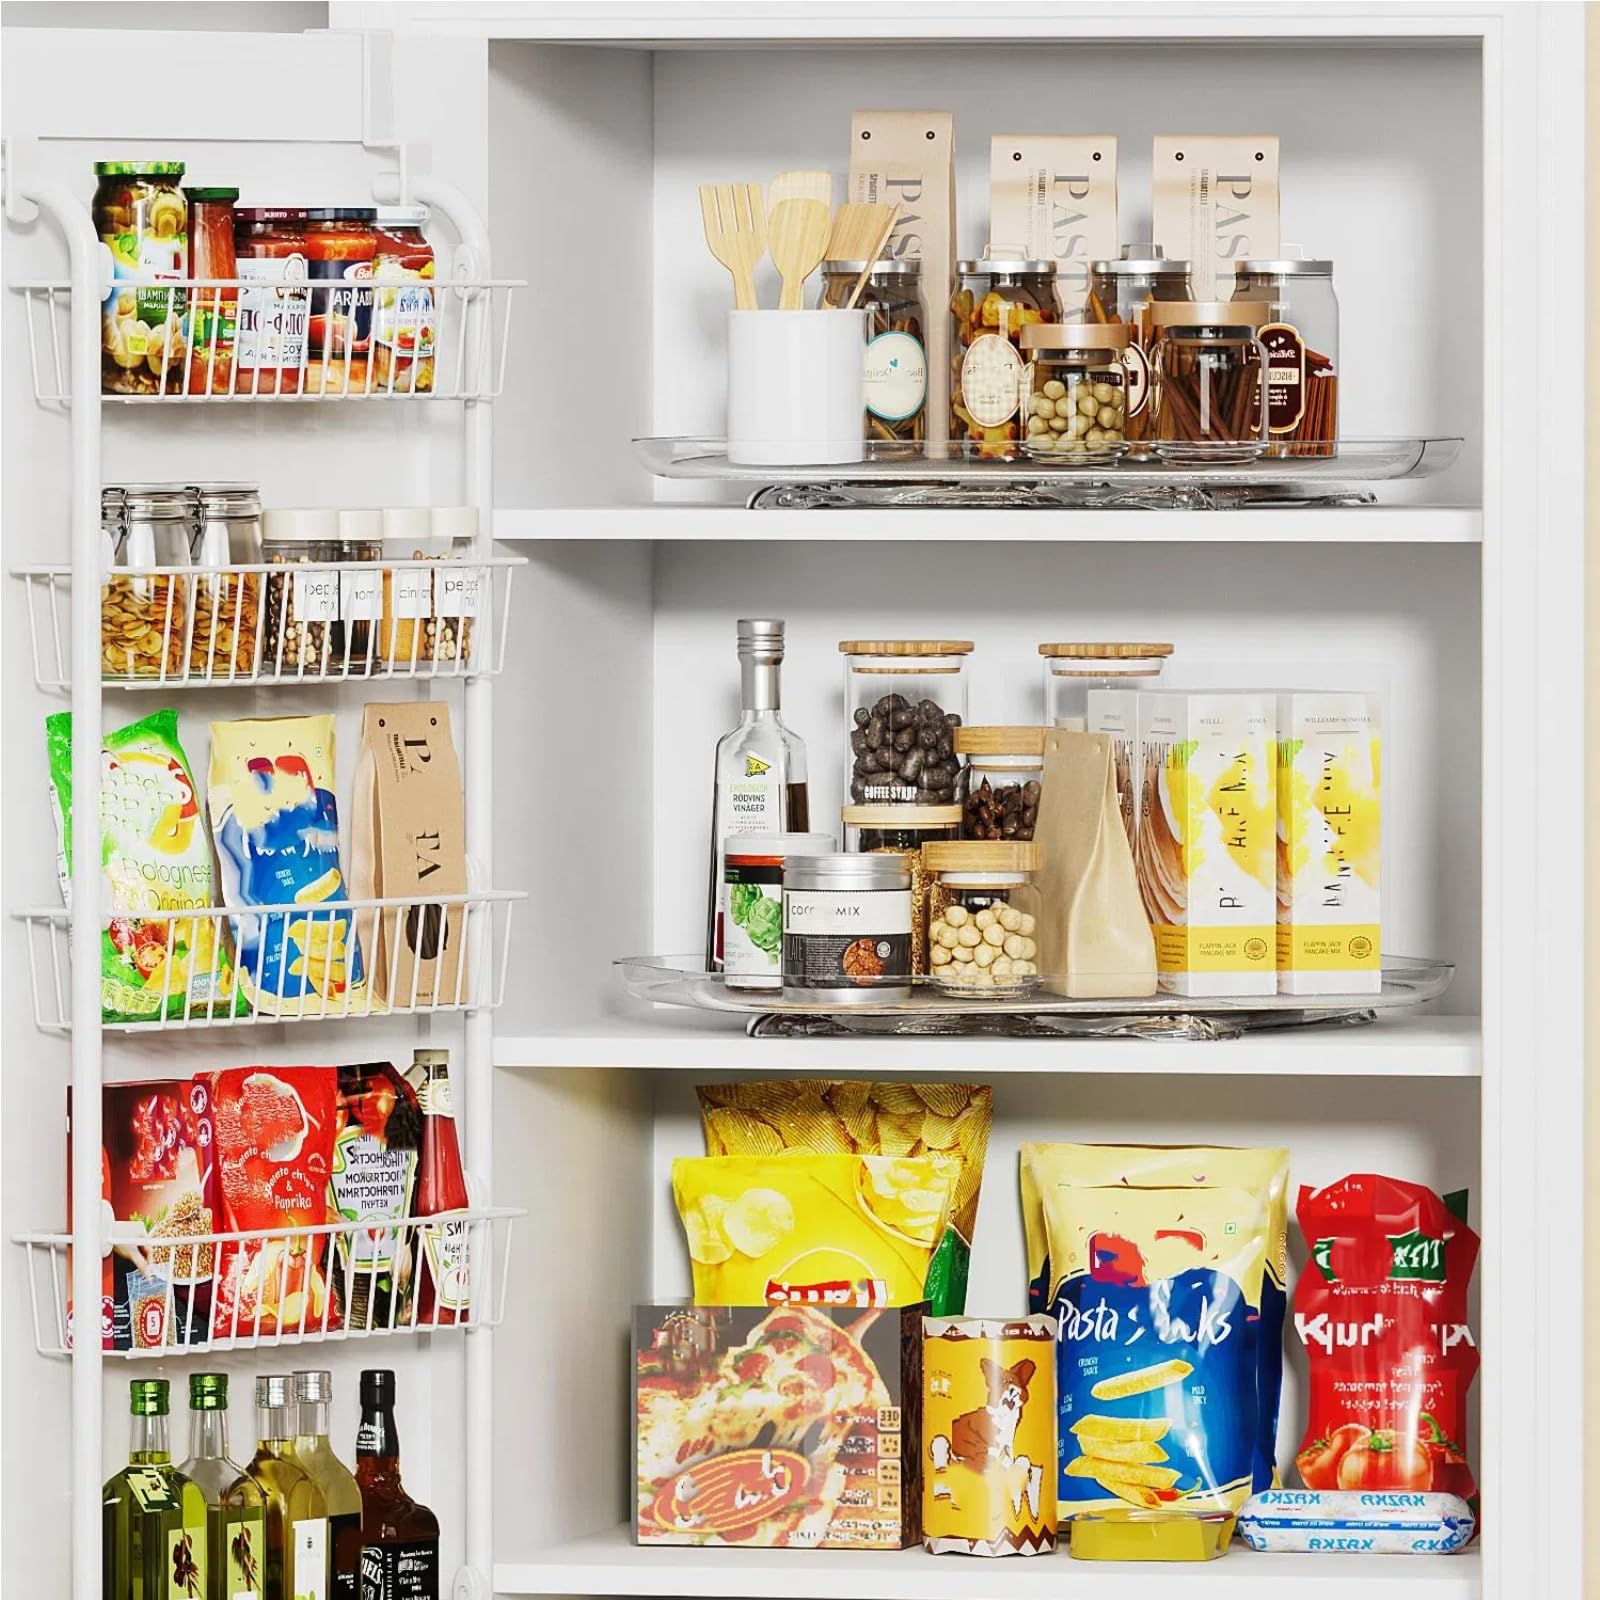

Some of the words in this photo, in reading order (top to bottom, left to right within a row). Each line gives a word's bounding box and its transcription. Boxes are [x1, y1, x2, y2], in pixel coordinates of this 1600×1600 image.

[835, 906, 861, 916] MIX
[274, 1191, 313, 1214] Paprika
[1057, 1296, 1119, 1343] Pasta
